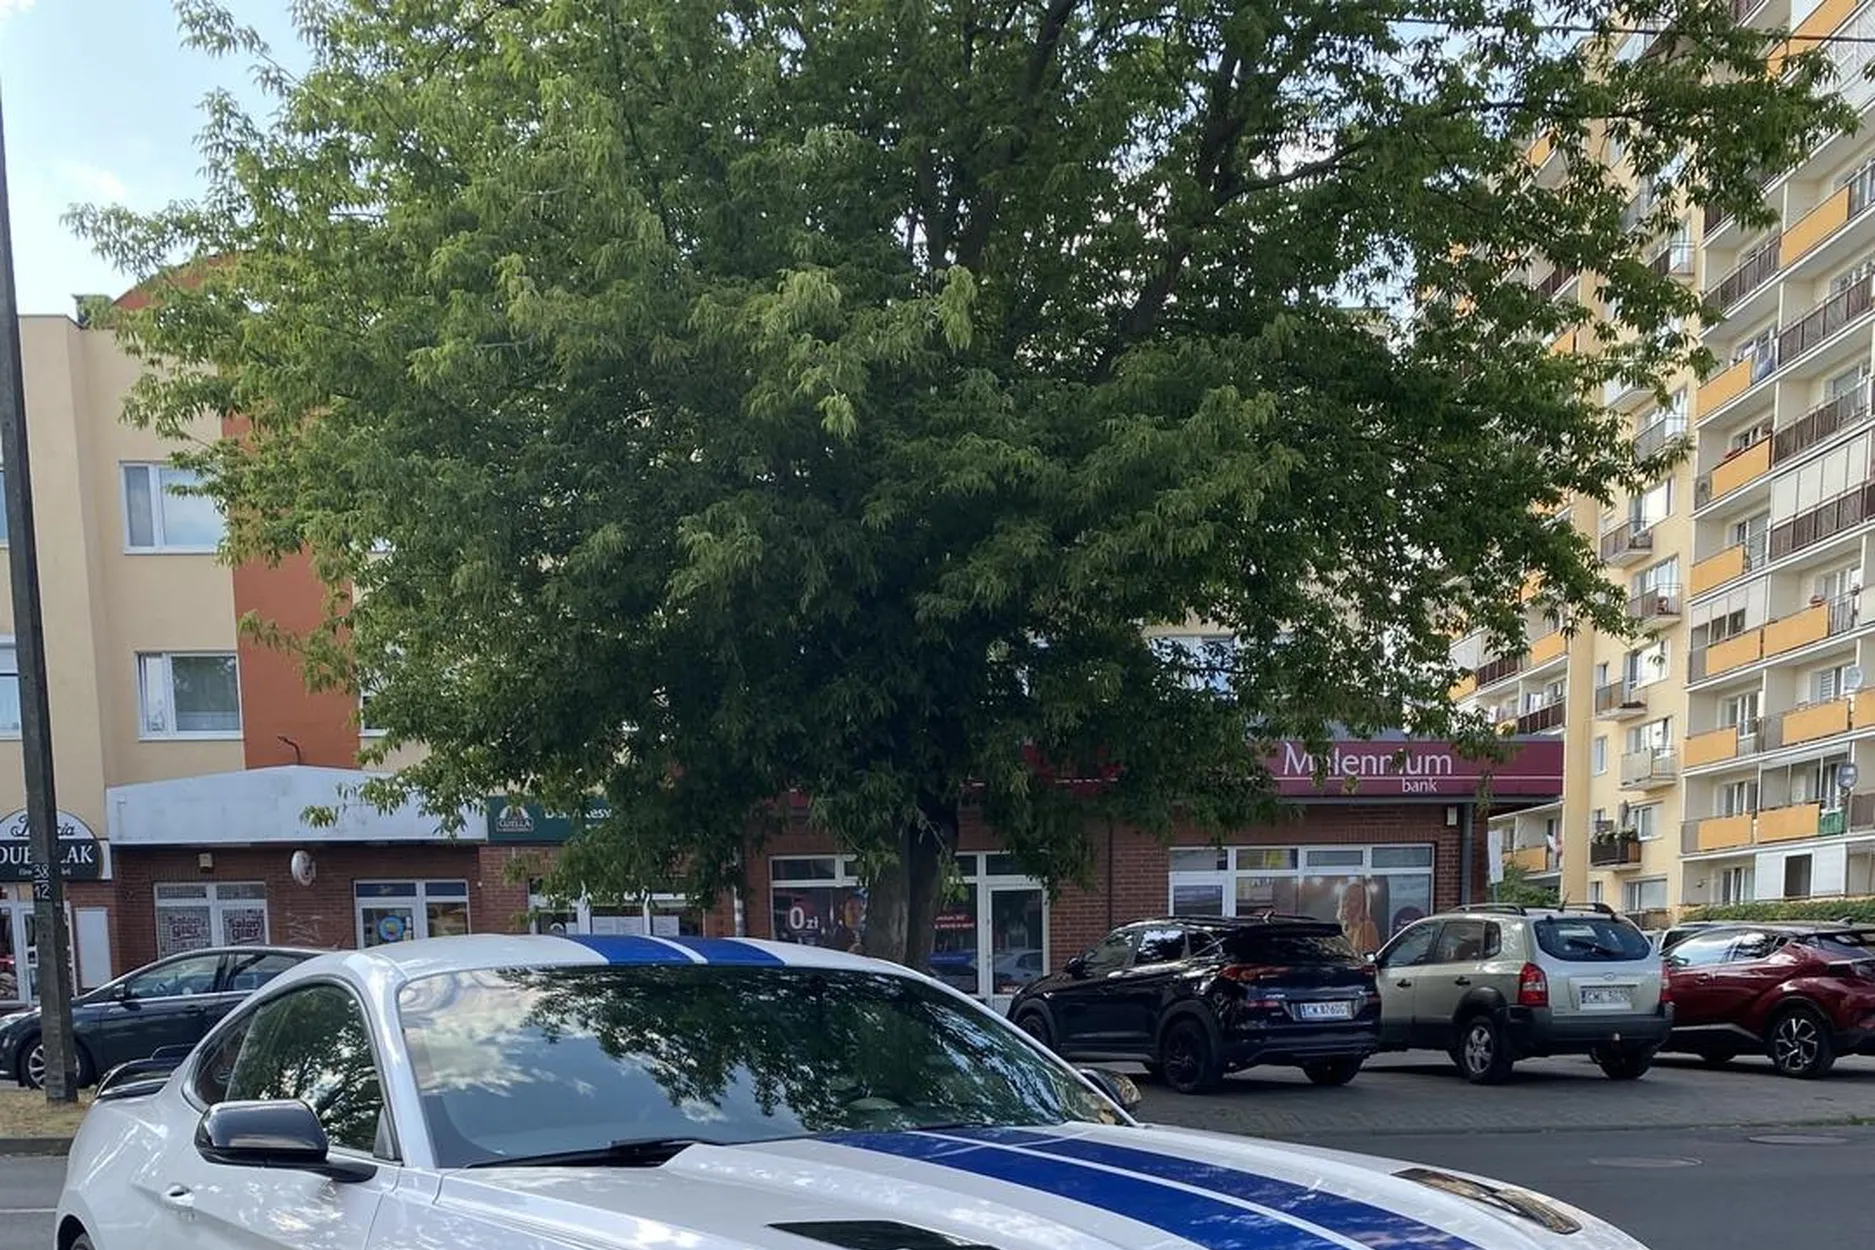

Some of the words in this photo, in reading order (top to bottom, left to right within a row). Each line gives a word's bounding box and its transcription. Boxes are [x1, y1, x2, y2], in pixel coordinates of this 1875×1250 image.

[1283, 742, 1452, 776] Mllennum
[1401, 776, 1438, 793] bank
[33, 863, 50, 879] 38
[34, 883, 51, 900] 12
[789, 906, 805, 930] 0
